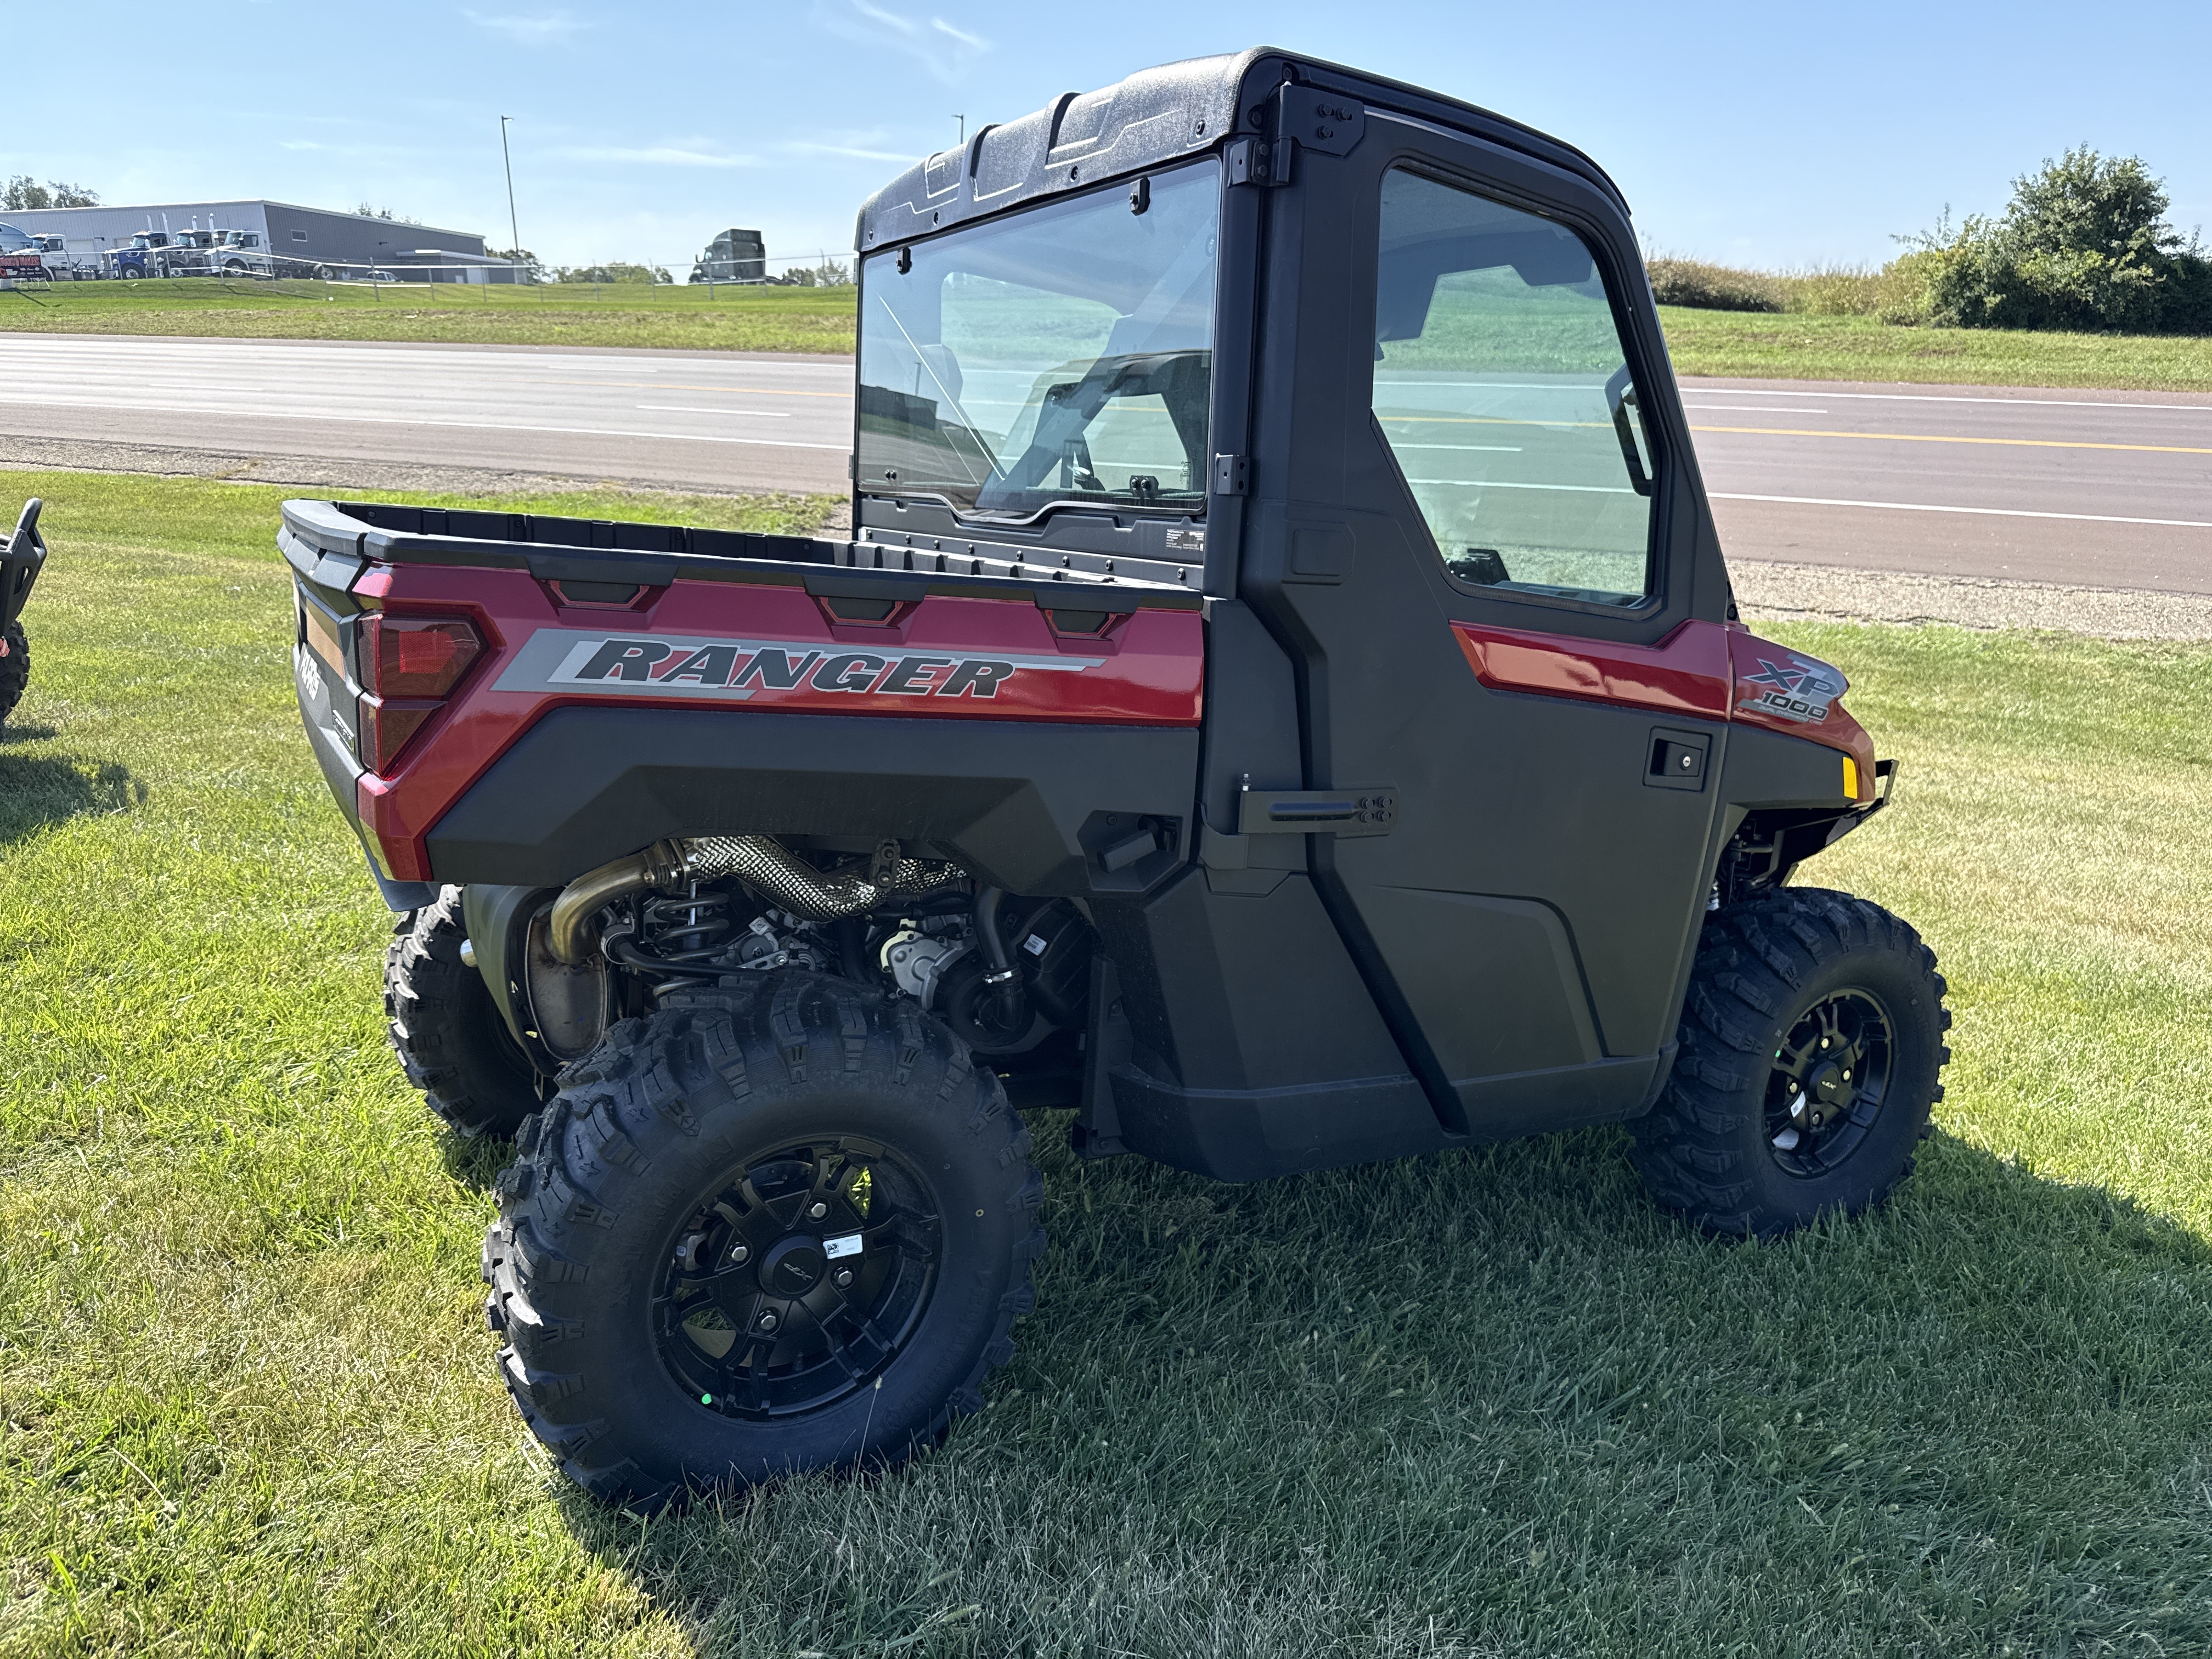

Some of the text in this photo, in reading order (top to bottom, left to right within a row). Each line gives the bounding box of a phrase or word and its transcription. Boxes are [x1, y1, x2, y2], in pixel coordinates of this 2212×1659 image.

[575, 637, 1015, 698] RANGER
[1742, 658, 1839, 697] XP
[1758, 705, 1822, 726] DUAL OVERHEAD CAM
[1760, 691, 1829, 721] 1000
